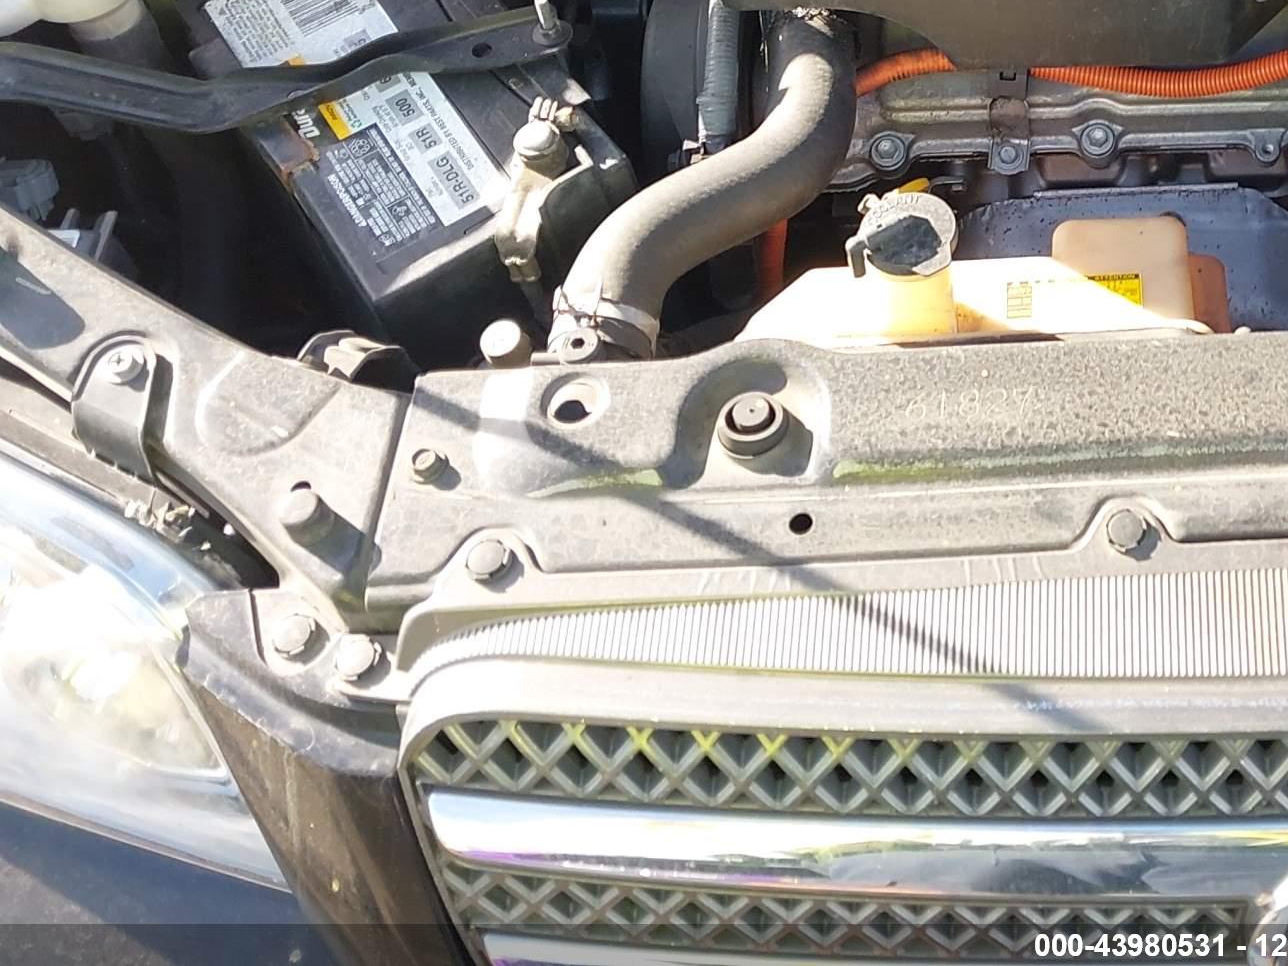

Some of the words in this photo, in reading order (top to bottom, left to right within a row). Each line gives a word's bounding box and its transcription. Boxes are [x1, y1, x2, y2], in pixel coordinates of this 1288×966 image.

[395, 97, 415, 118] 500
[415, 127, 437, 149] 51R
[435, 155, 475, 205] 51R-DLG
[905, 385, 1034, 420] 61827
